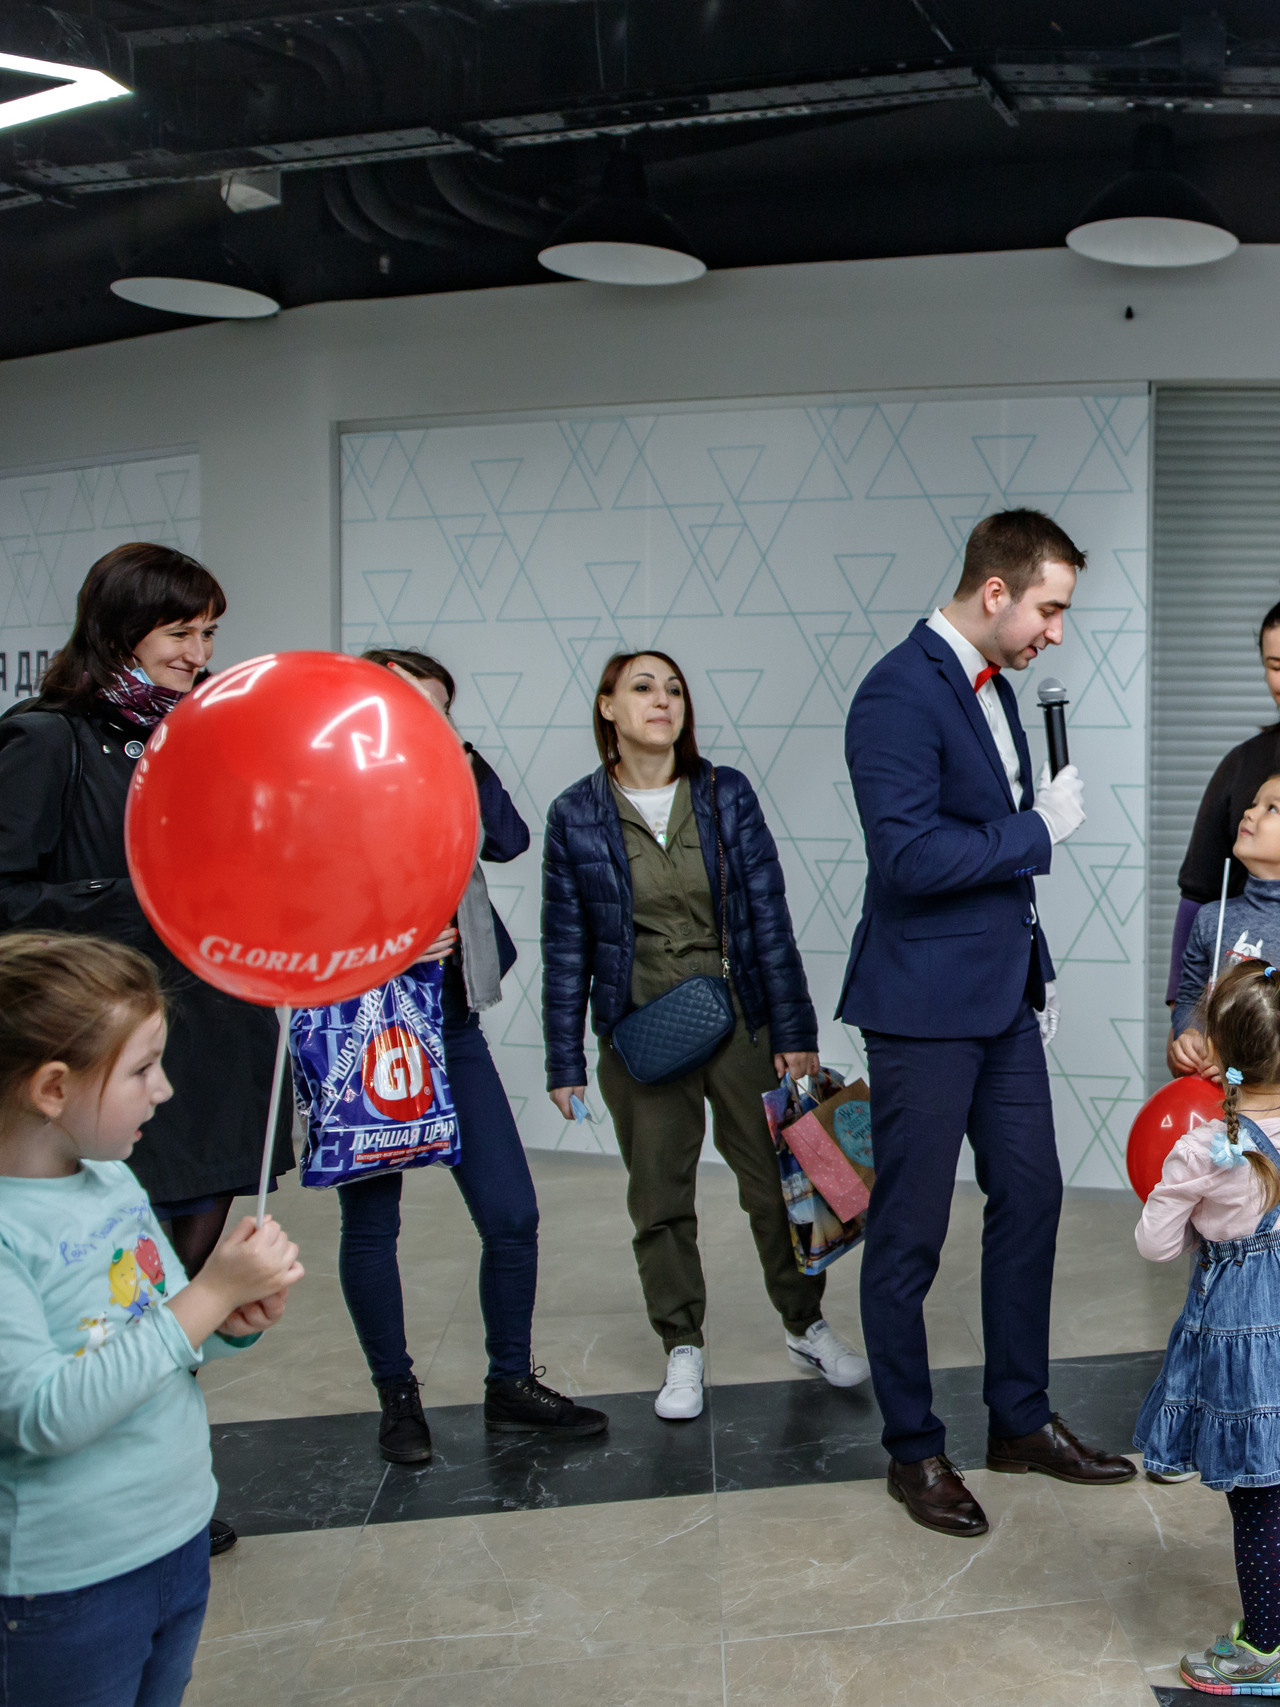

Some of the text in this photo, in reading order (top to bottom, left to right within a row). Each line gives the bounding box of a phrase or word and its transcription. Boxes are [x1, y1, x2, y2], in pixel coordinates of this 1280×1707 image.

[199, 927, 418, 982] GLORIA JEANS
[373, 1046, 422, 1100] GJ
[349, 1128, 421, 1151] ЛУЧШАЯ
[423, 1120, 455, 1143] ЦЕНА
